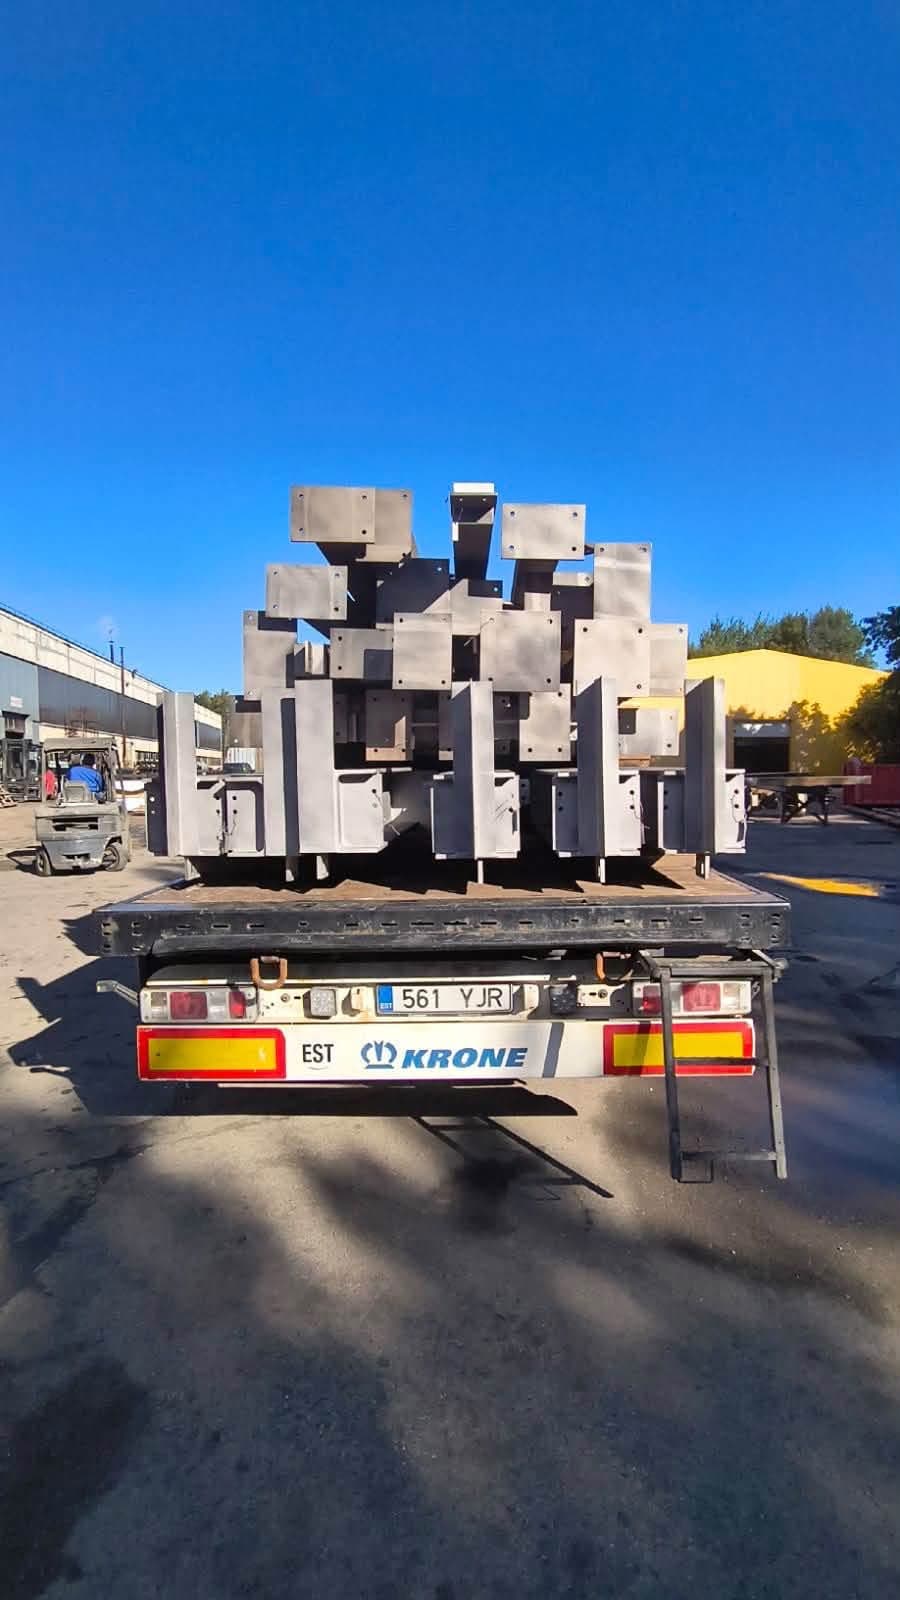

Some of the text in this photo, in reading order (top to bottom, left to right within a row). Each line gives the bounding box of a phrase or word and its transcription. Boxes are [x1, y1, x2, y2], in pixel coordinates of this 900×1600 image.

[402, 987, 503, 1008] 561 YJR
[302, 1043, 334, 1063] EST
[401, 1047, 528, 1069] KRONE
